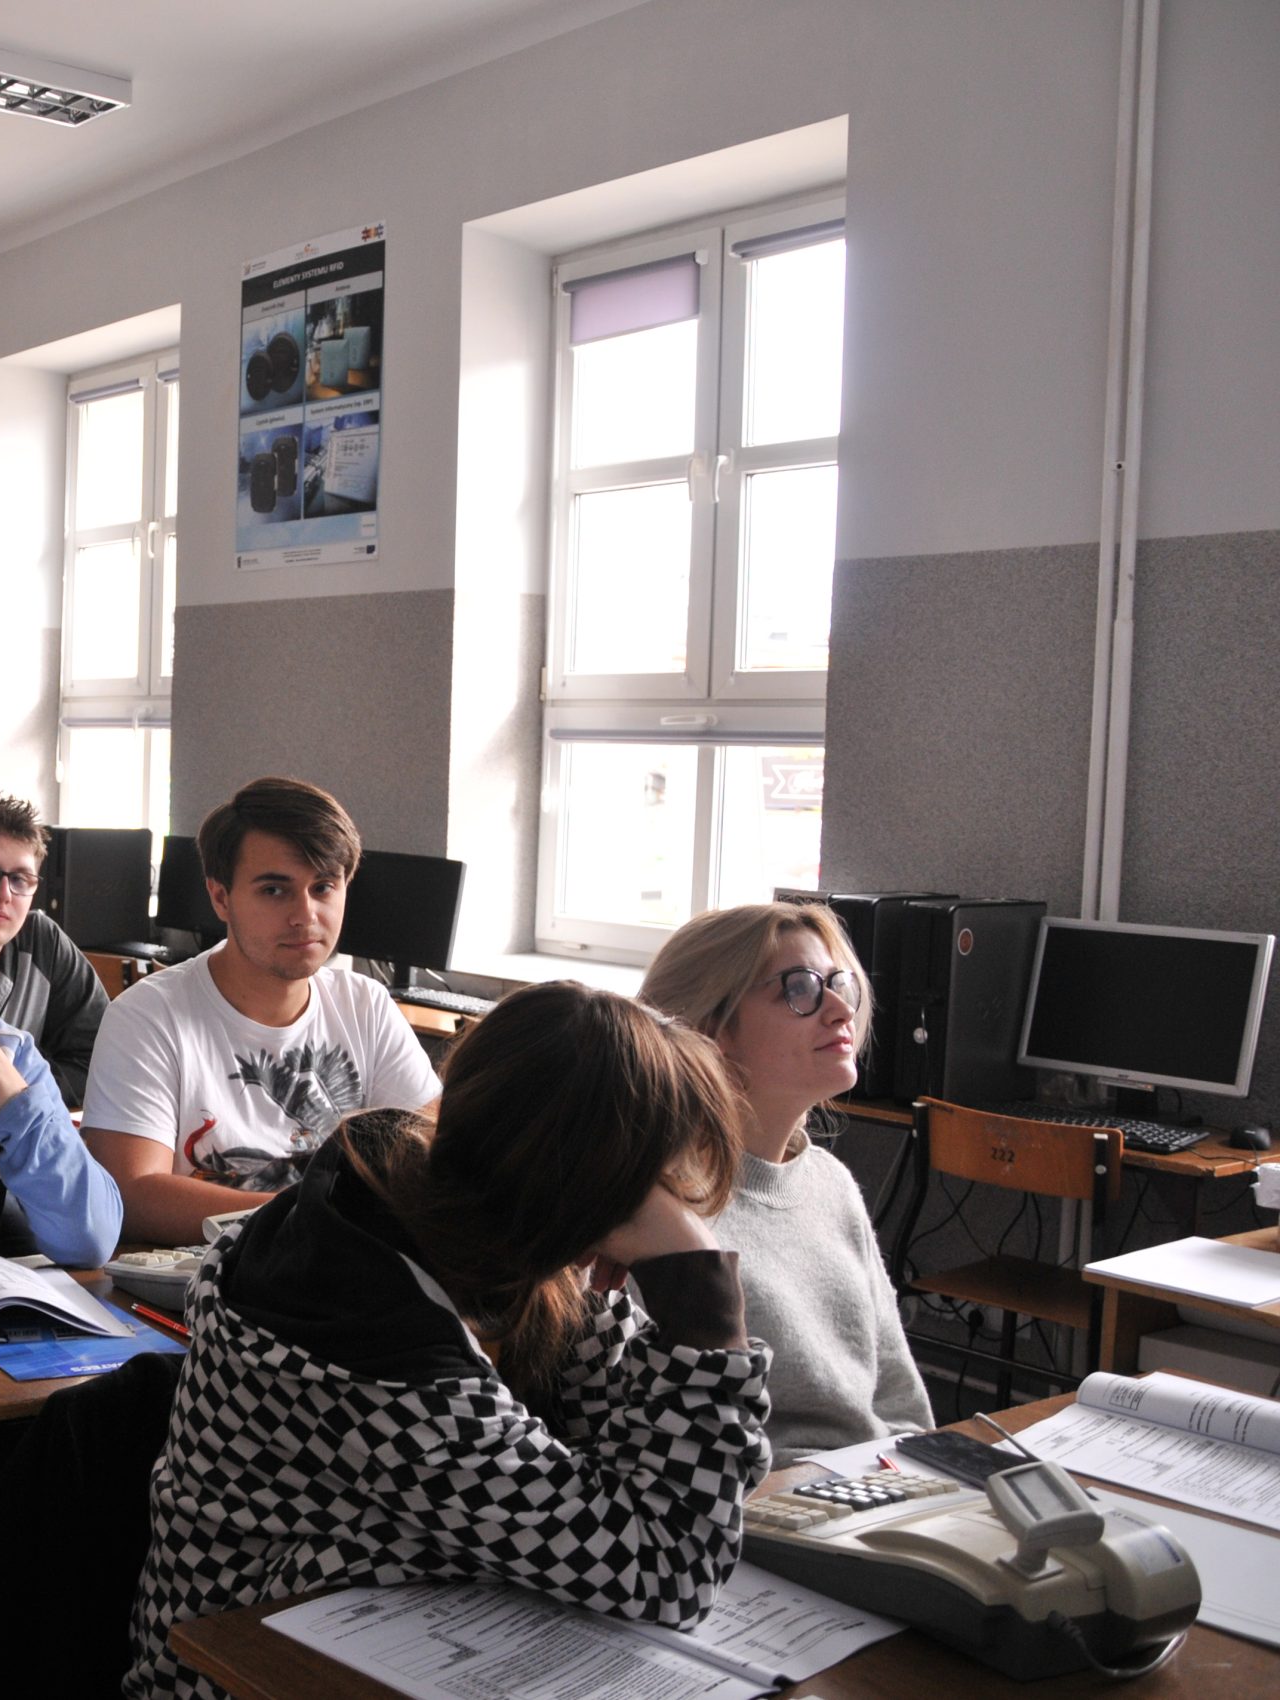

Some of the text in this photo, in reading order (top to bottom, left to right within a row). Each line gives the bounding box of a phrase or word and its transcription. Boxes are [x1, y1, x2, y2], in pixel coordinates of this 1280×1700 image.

[272, 261, 345, 289] ELEMENTY SYSTEMU RFID
